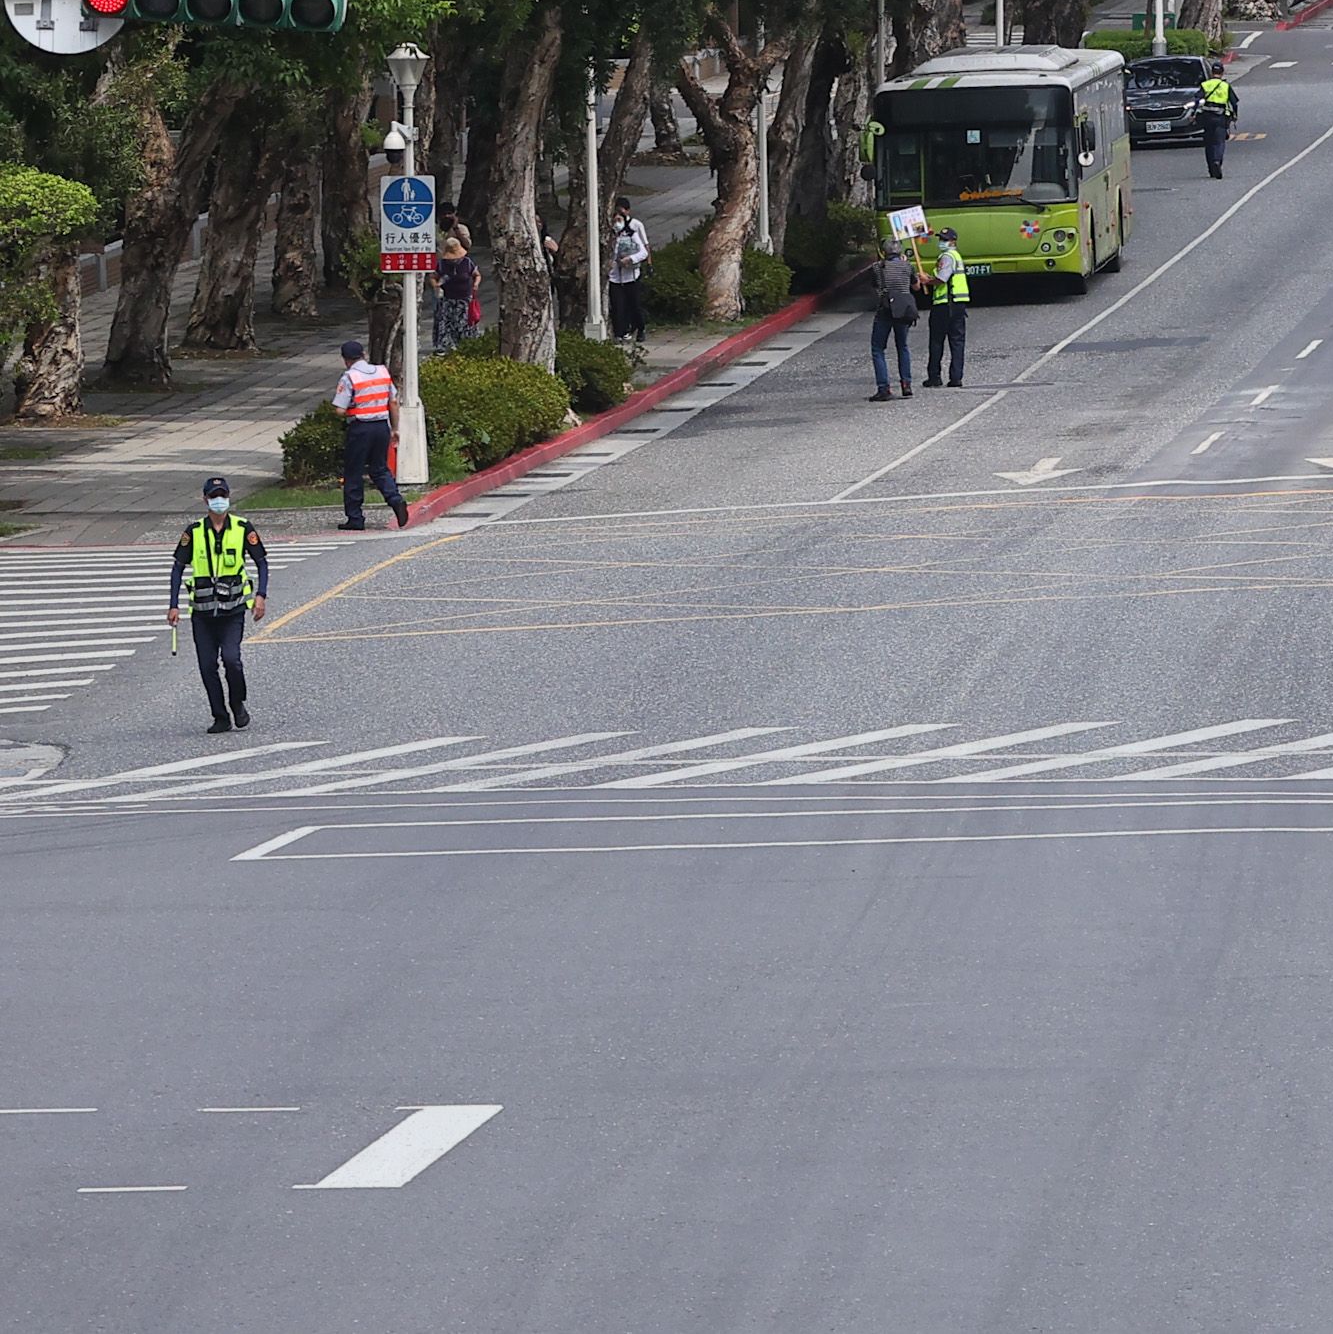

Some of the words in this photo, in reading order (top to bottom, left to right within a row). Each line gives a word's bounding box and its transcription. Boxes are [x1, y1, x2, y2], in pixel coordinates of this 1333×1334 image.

[385, 232, 433, 244] 行人優先
[965, 264, 992, 276] 307-FY
